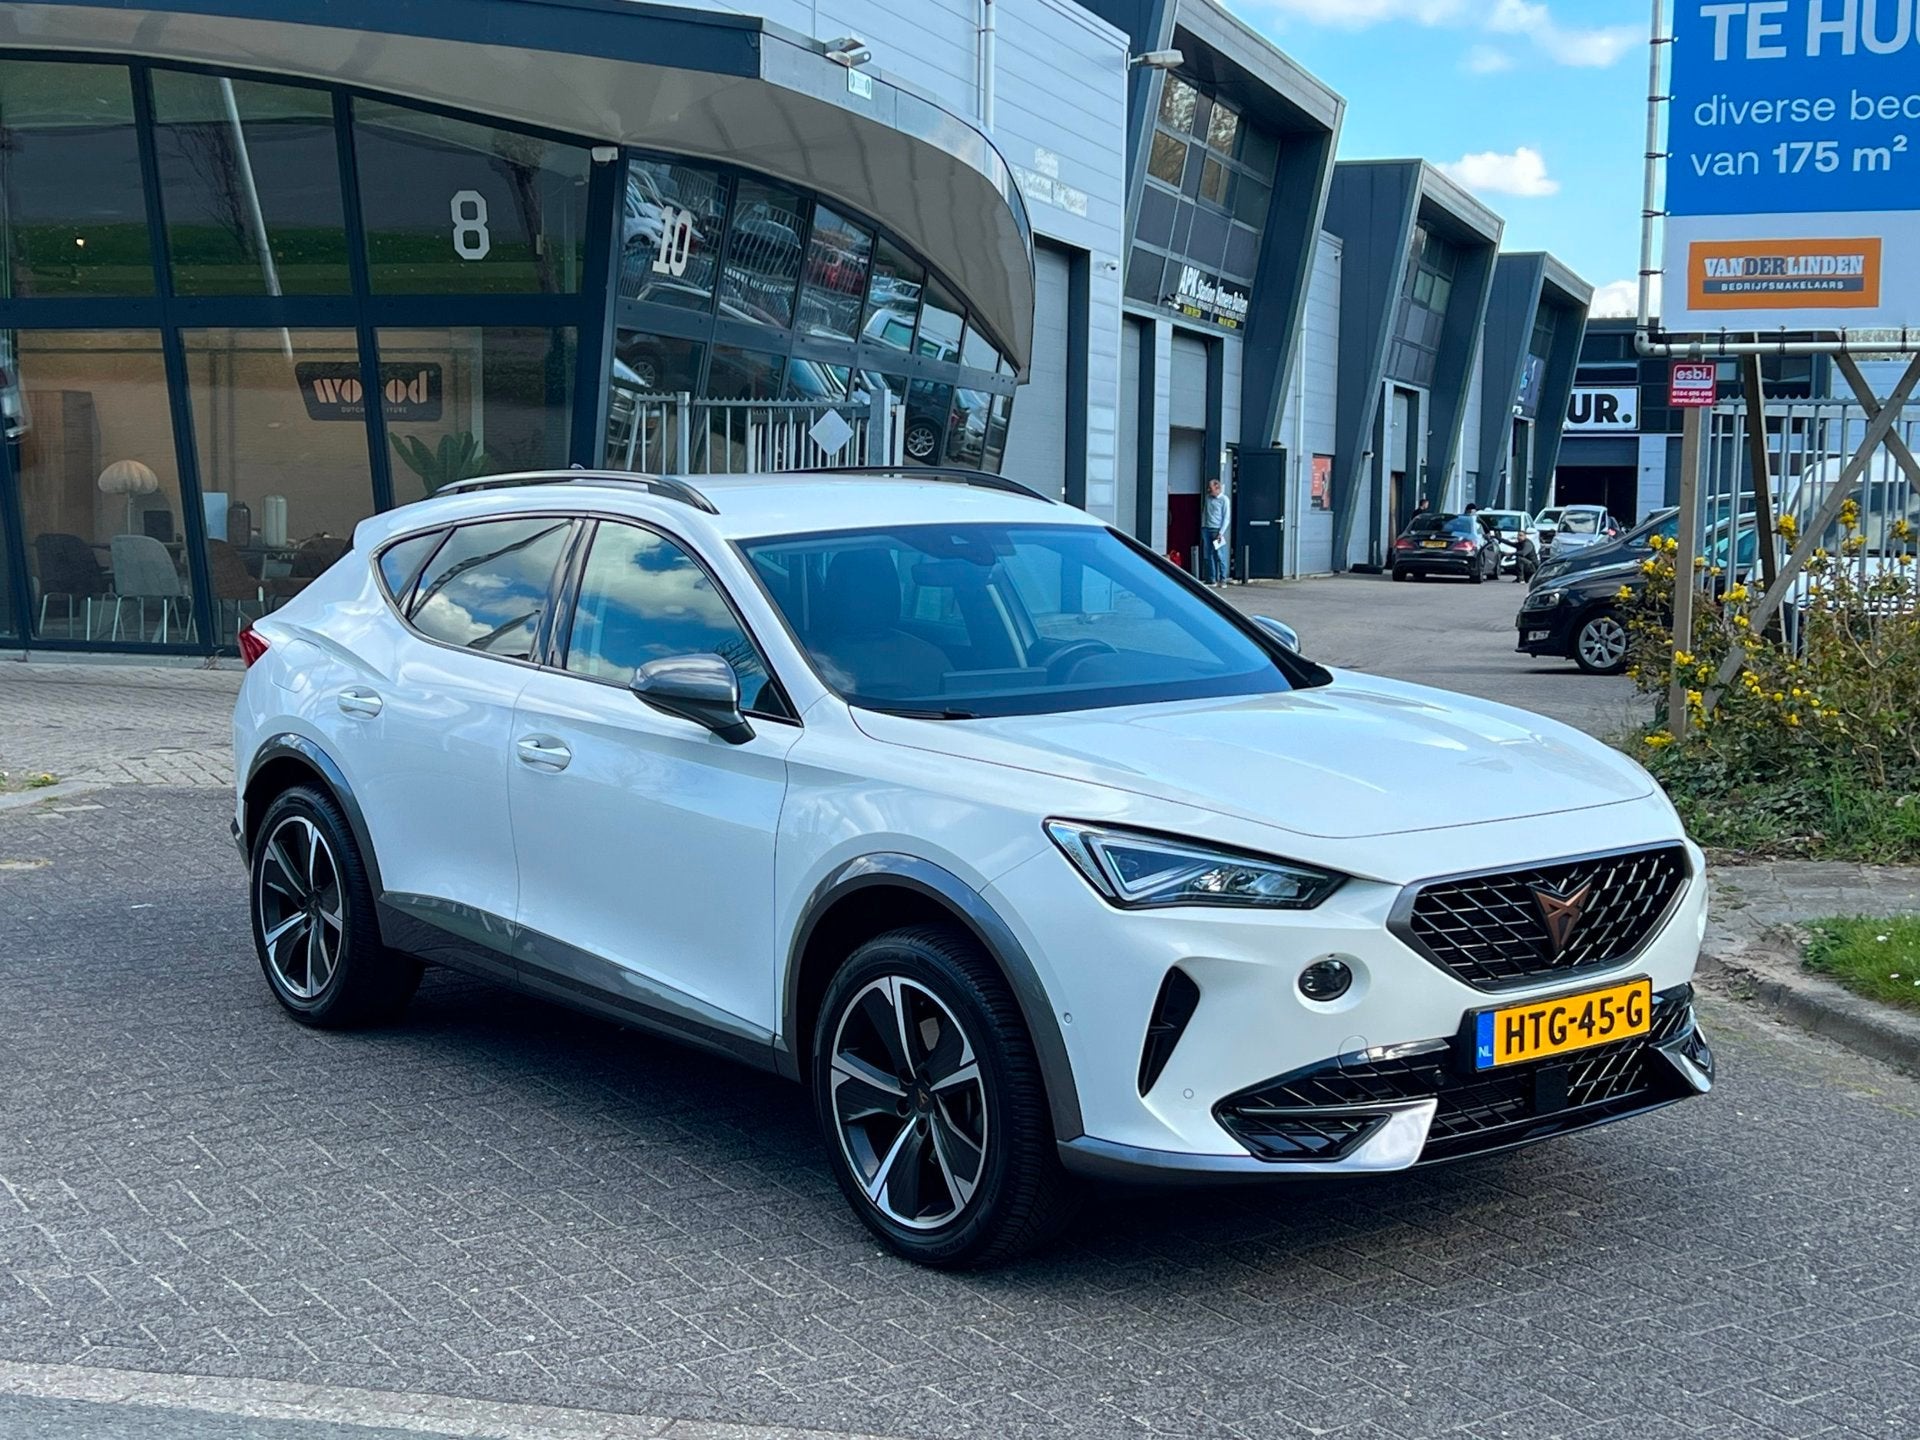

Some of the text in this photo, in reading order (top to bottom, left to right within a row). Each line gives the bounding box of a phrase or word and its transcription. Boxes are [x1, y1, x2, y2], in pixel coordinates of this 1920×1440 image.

[1700, 0, 1920, 61] TE HU
[1694, 94, 1836, 126] diverse
[1691, 135, 1908, 176] van 175 m²
[450, 190, 490, 260] 8
[652, 206, 692, 277] 10
[1178, 265, 1200, 298] APK
[1720, 281, 1845, 292] BEDRIJFSMAKELAARS
[313, 370, 428, 405] wood
[1676, 366, 1710, 380] esbi.
[1505, 990, 1643, 1056] HTG-45-G
[1478, 1047, 1492, 1058] NL
